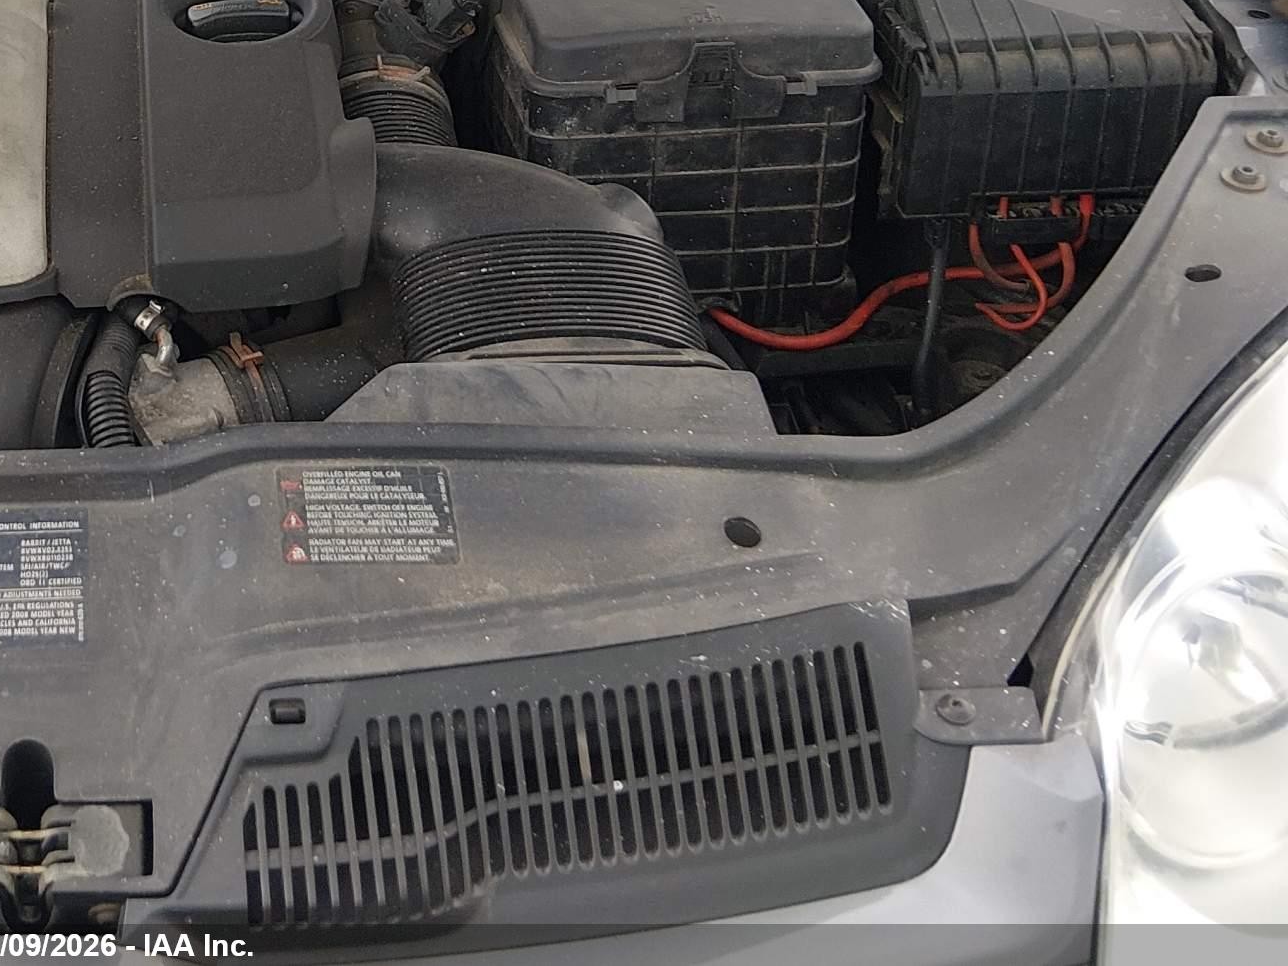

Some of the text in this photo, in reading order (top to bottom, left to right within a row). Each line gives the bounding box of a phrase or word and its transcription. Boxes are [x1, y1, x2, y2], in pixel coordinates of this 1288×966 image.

[30, 521, 80, 530] INFORMATION
[309, 538, 346, 546] RADIATOR
[347, 538, 363, 546] FAN
[364, 538, 381, 546] MAY
[384, 538, 405, 546] START
[407, 538, 417, 546] AT
[418, 538, 434, 546] ANY
[30, 610, 55, 618] MODEL
[56, 609, 74, 617] YEAR
[17, 619, 33, 627] AND
[14, 627, 39, 635] MODEL
[40, 626, 57, 634] YEAR
[59, 625, 75, 634] NEW
